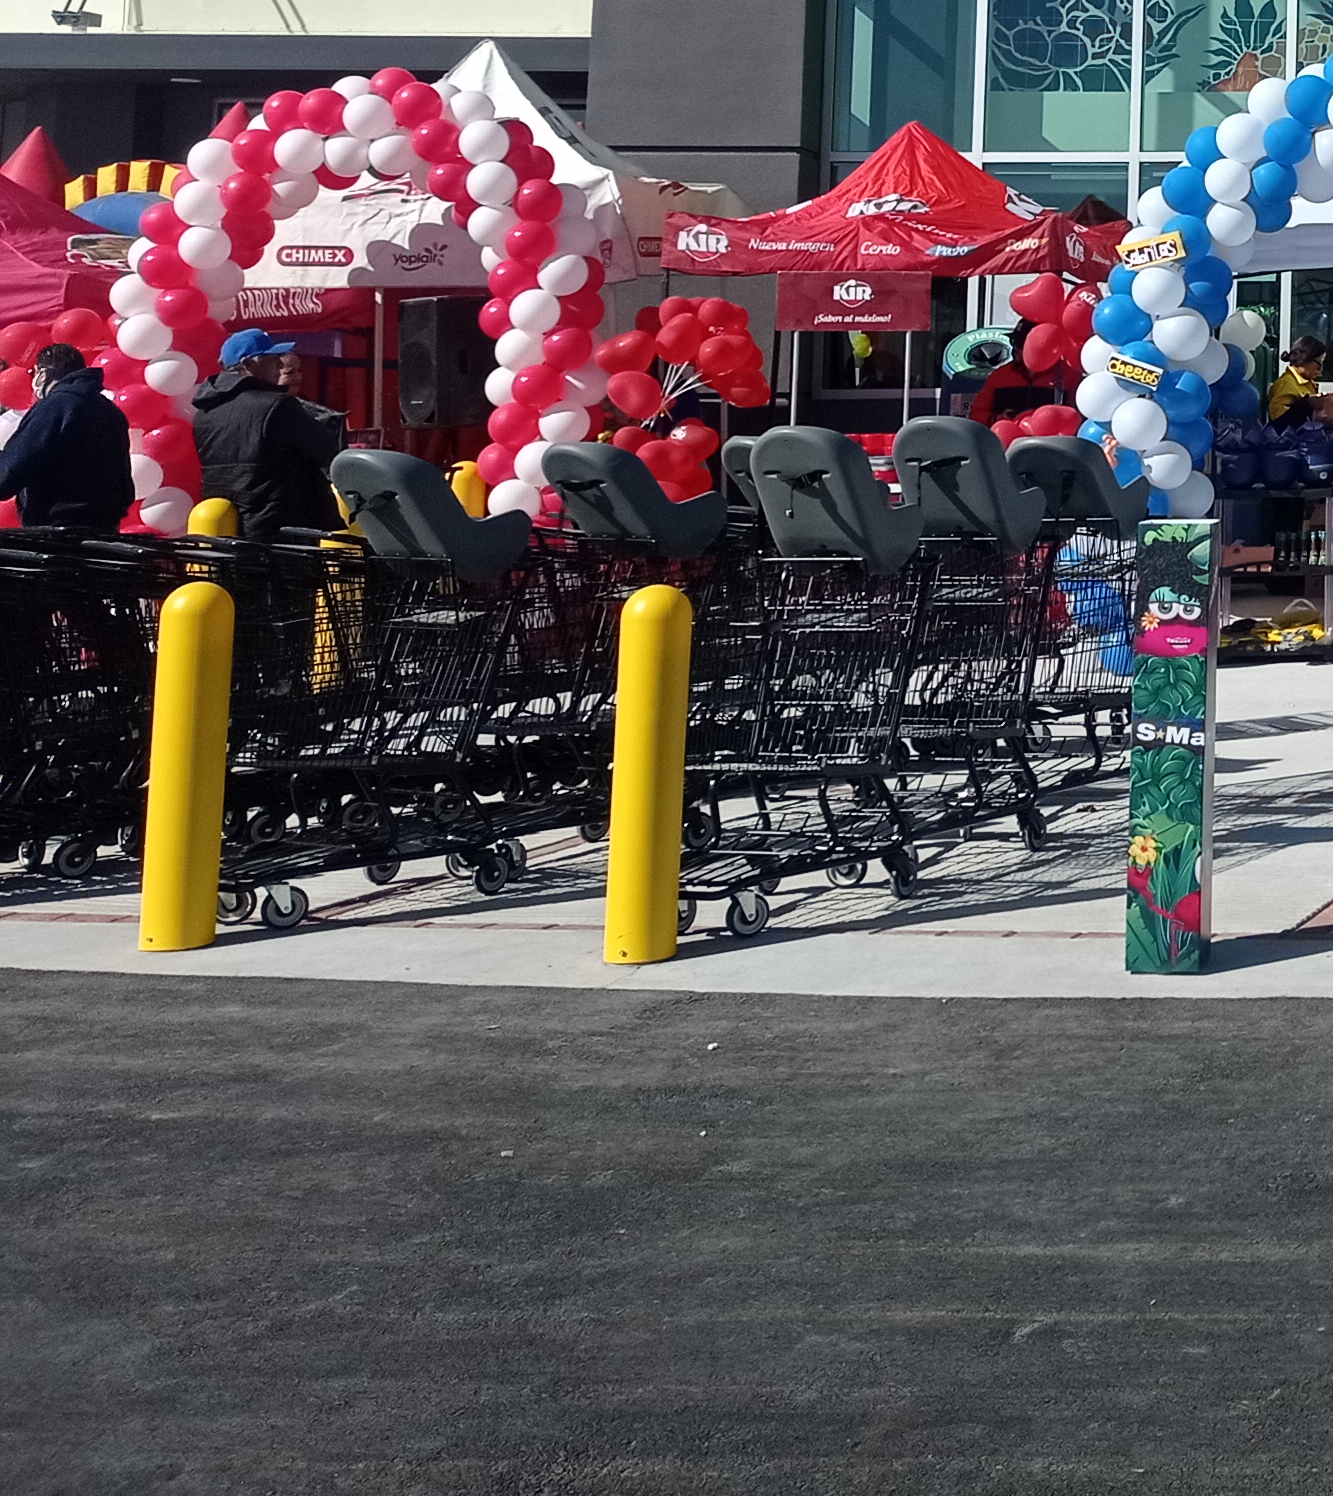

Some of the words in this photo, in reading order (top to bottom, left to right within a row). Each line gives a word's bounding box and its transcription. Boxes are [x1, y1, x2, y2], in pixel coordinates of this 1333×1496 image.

[748, 238, 787, 251] Nueva
[860, 241, 901, 255] Cerdo
[280, 248, 347, 264] CHIMEX
[238, 289, 289, 320] CARNES
